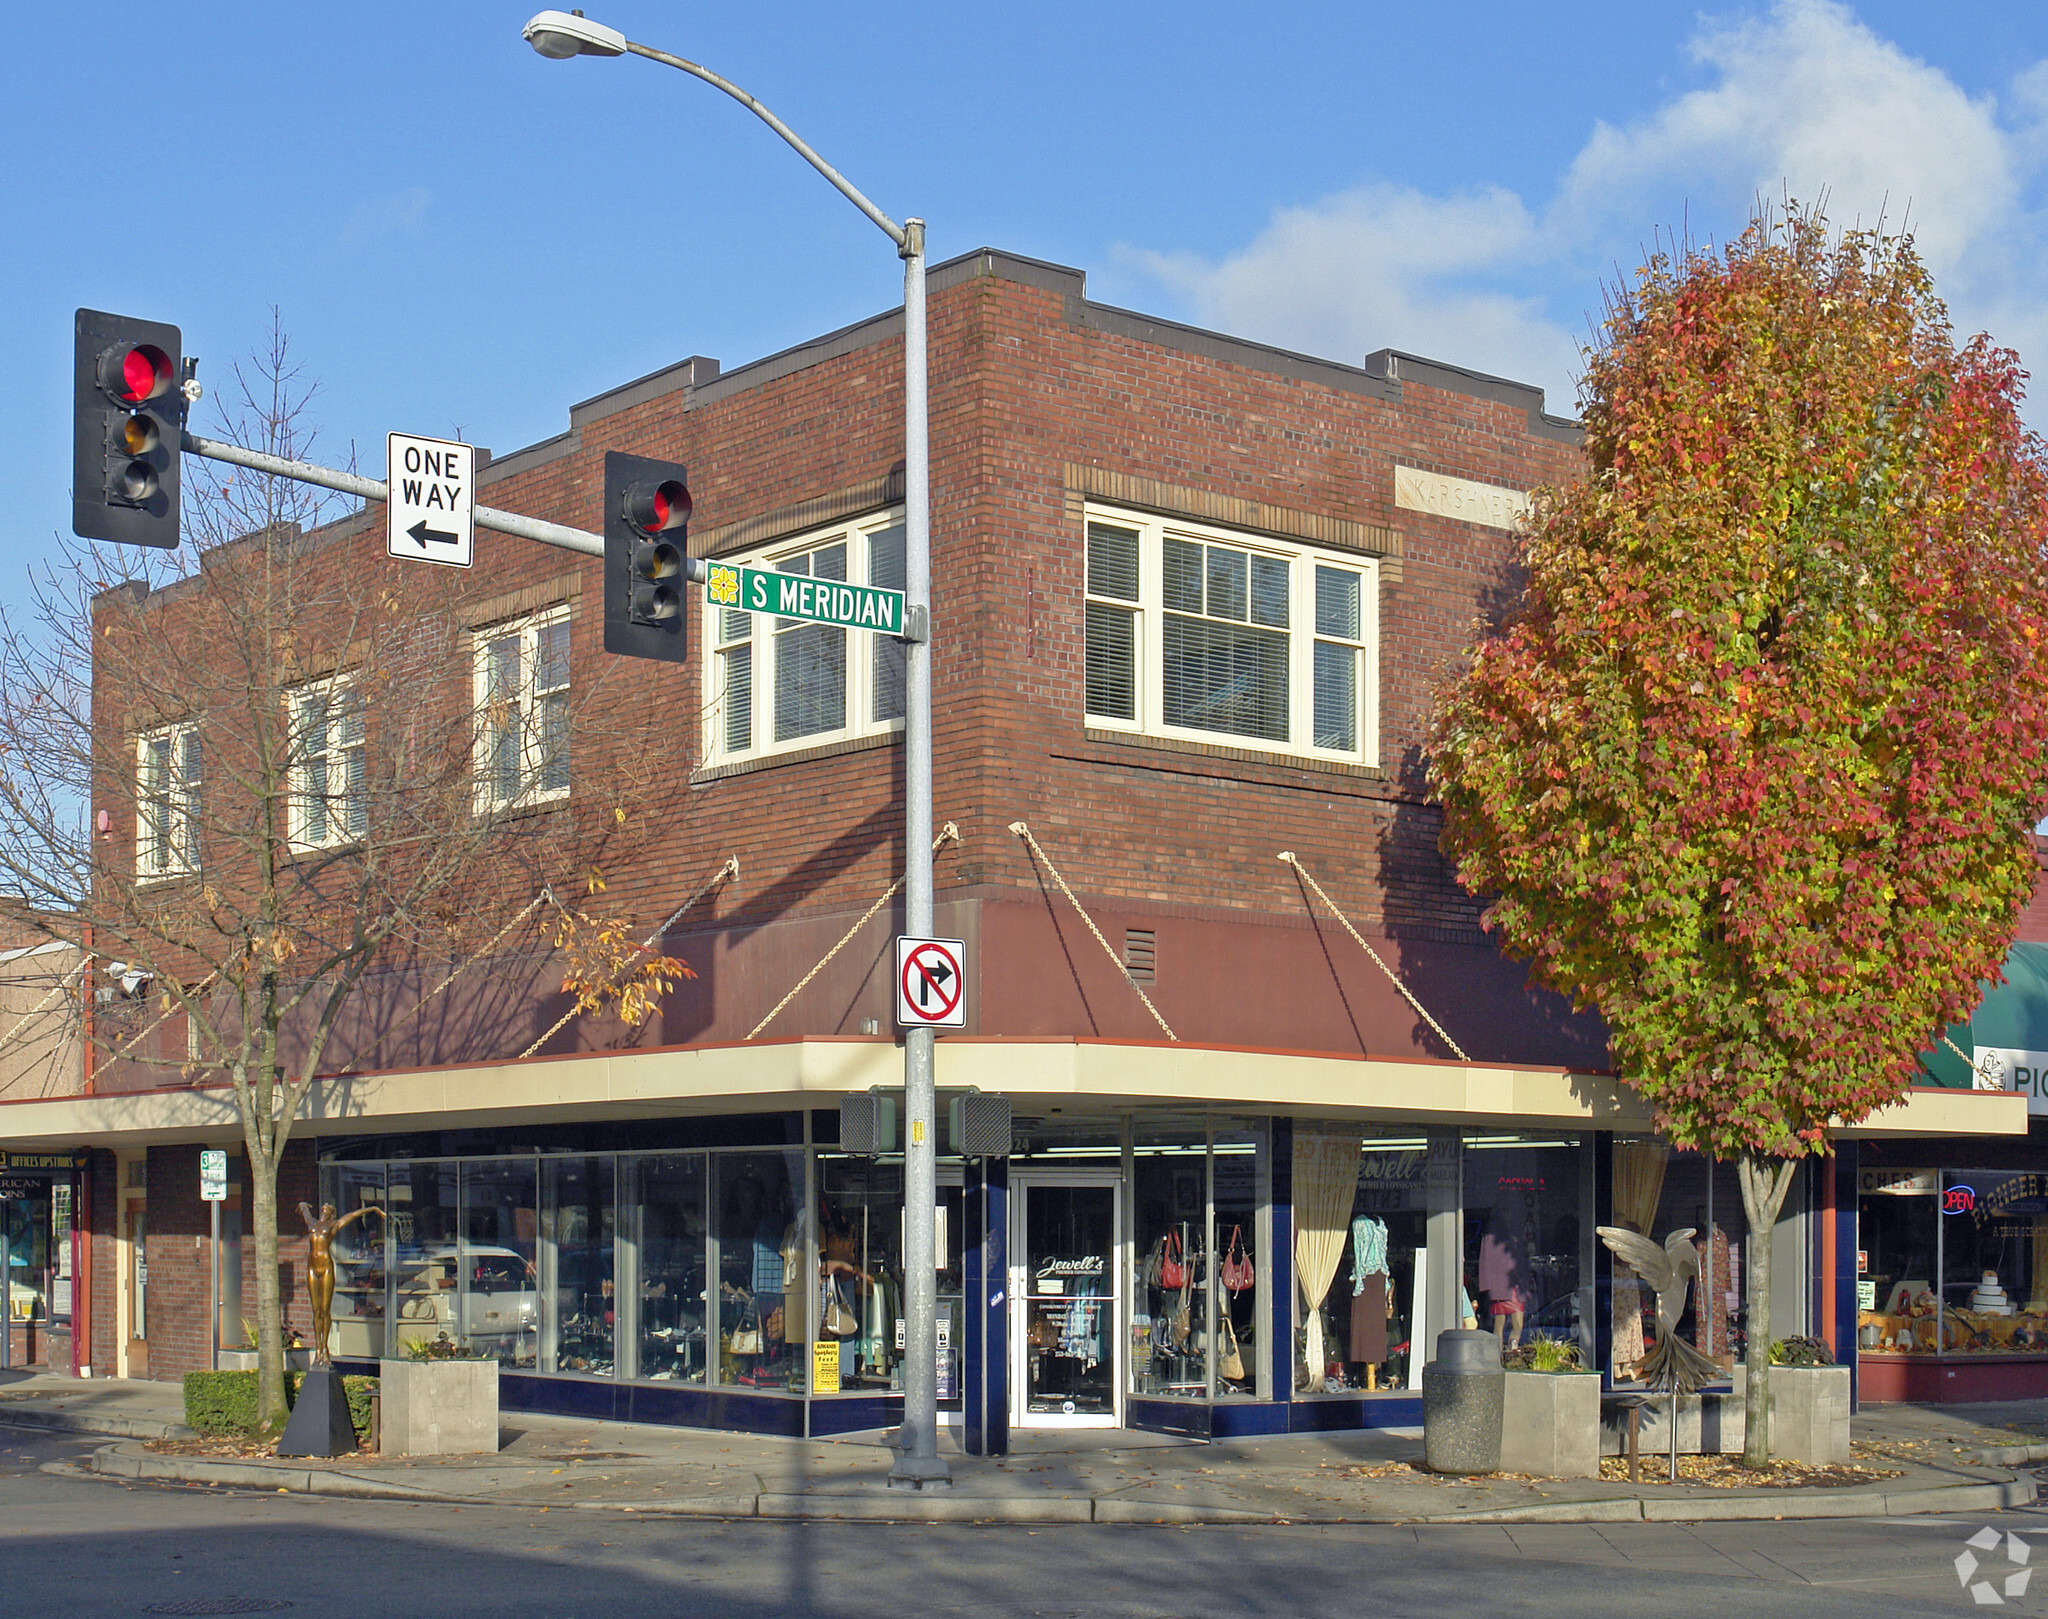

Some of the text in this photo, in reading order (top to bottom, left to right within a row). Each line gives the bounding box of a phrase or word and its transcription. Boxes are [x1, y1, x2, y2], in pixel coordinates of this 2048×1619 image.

[405, 446, 459, 480] ONE
[402, 478, 462, 511] WAY
[752, 574, 894, 628] S MERIDIAN
[2014, 1066, 2048, 1098] PI
[11, 1156, 38, 1167] OFFICES
[202, 1155, 208, 1168] 3
[1863, 1172, 1915, 1190] CHES
[1943, 1190, 1975, 1210] OPEN
[1971, 1174, 2038, 1232] PIONEER
[1036, 1256, 1104, 1278] Jewell's
